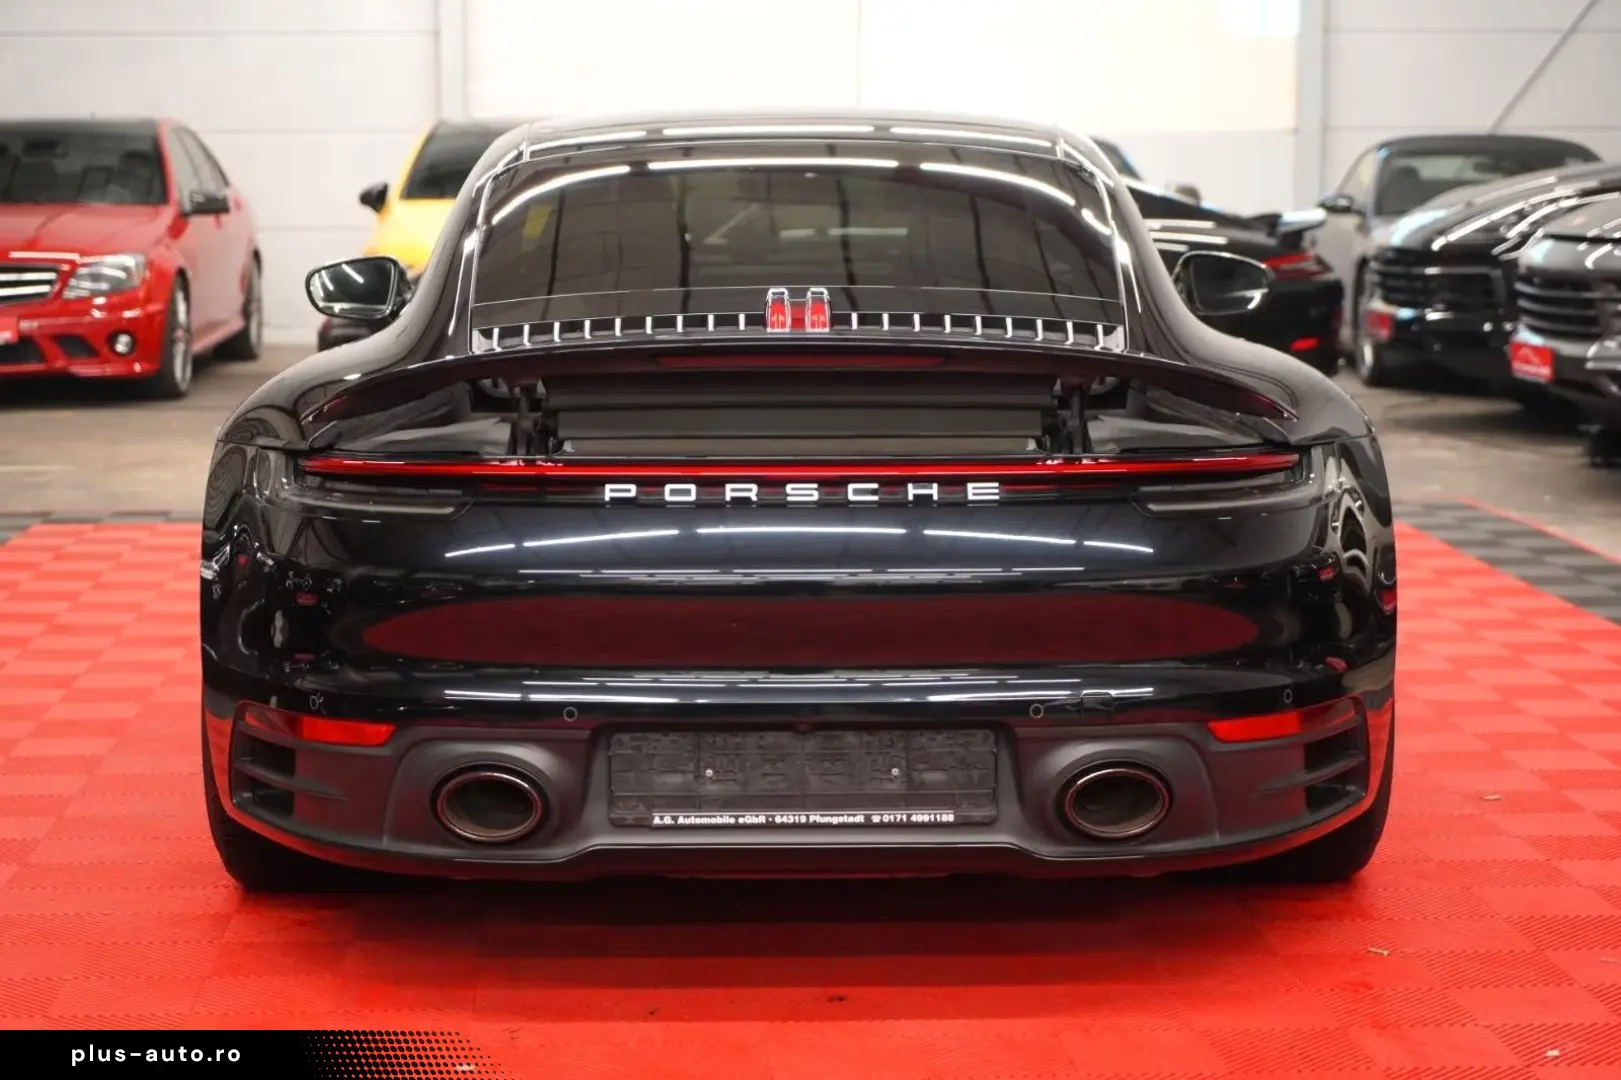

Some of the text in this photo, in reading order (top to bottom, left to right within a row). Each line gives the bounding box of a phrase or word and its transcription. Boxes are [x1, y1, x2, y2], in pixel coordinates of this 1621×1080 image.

[604, 482, 1000, 501] PORSCHE
[653, 815, 674, 825] A.G.
[677, 815, 735, 825] Automobile
[774, 814, 807, 825] 64319
[809, 813, 864, 825] Pfungstadt
[882, 814, 907, 823] 0171
